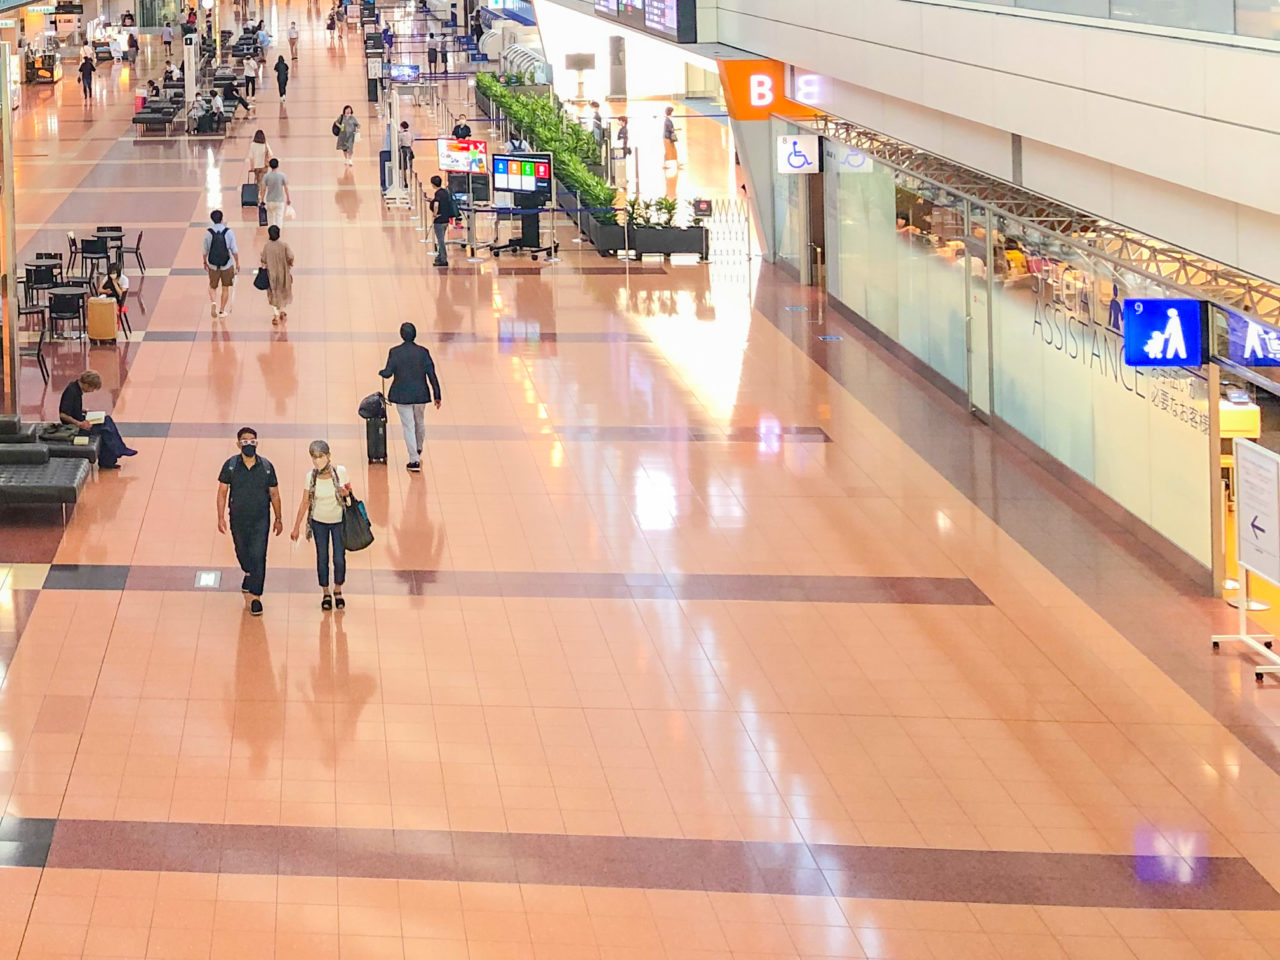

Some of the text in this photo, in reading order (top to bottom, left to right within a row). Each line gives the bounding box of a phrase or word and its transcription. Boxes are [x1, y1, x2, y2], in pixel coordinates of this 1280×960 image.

[750, 74, 773, 106] B
[1032, 252, 1102, 327] SPECIAL
[1134, 302, 1143, 315] 9
